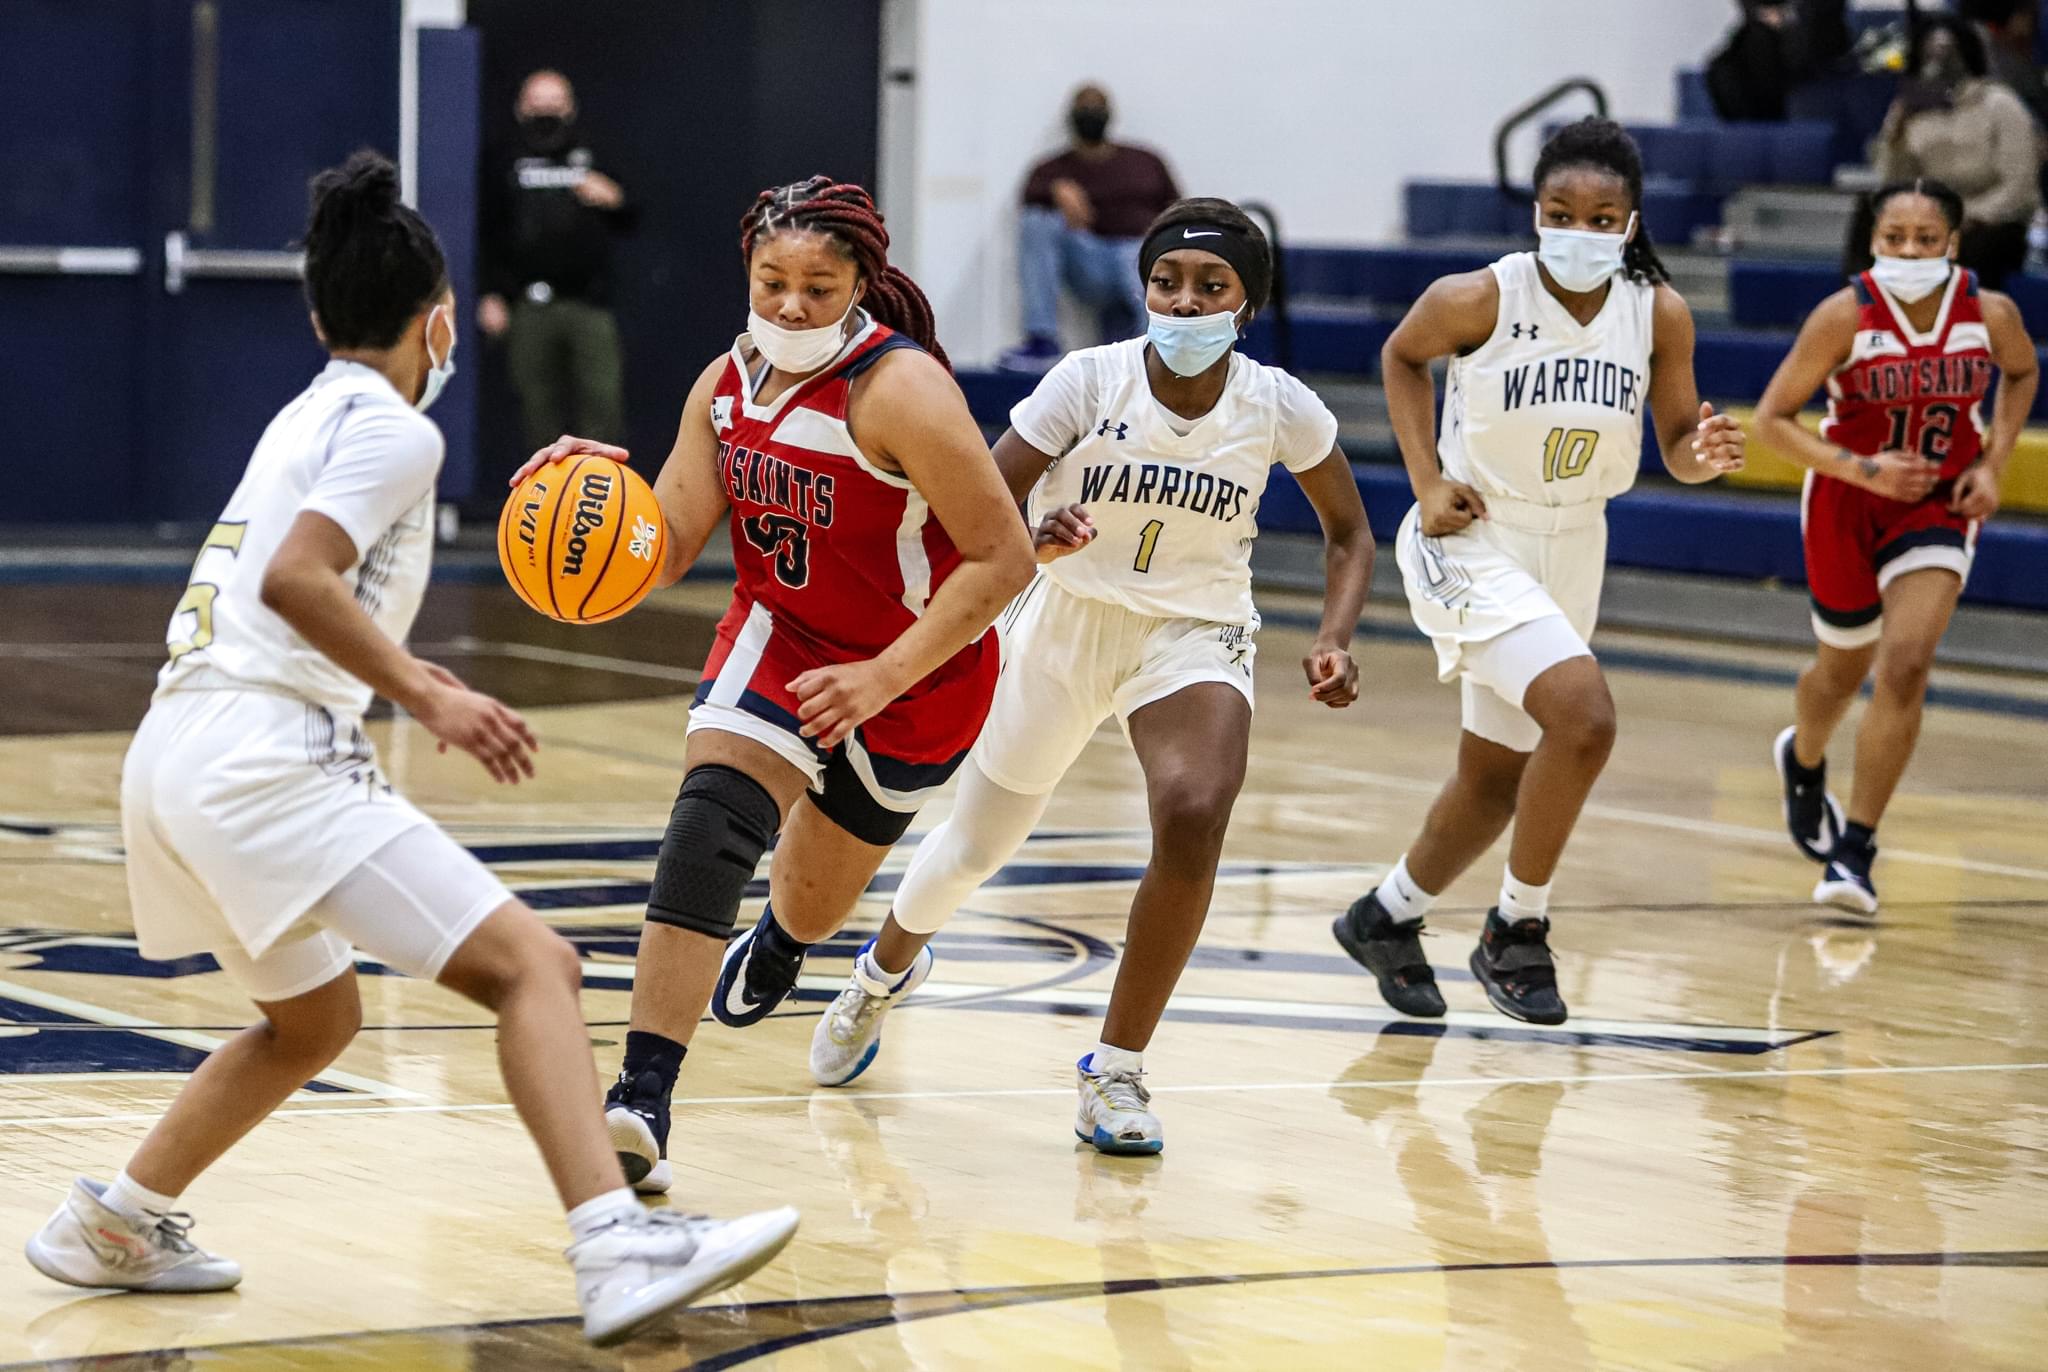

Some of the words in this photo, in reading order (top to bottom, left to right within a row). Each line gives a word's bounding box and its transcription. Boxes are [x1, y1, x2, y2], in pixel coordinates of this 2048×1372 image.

[1543, 427, 1599, 482] 10
[1880, 401, 1960, 462] 12
[731, 445, 835, 528] SAINTS
[1080, 464, 1248, 522] WARRIORS
[562, 473, 613, 576] Wilson
[1133, 519, 1164, 573] 1
